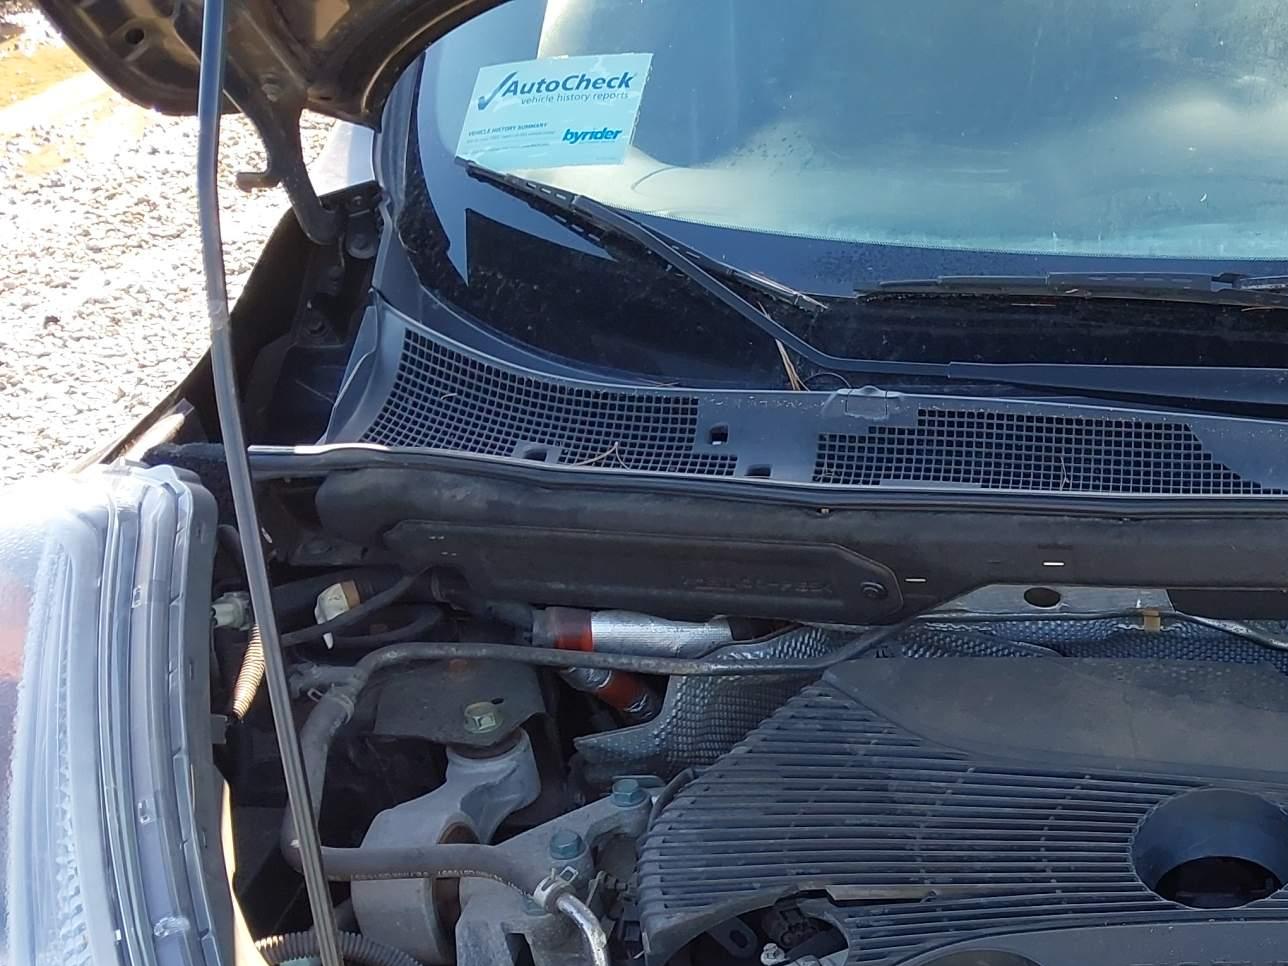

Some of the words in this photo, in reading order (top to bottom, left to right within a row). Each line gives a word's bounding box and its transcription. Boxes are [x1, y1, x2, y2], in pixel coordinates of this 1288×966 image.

[501, 72, 634, 97] AutoCheck
[521, 95, 554, 105] vehicle
[556, 92, 592, 104] history
[593, 91, 629, 101] reports
[491, 125, 517, 135] HISTORY
[517, 122, 548, 131] SUMMARY
[562, 127, 623, 144] byrider
